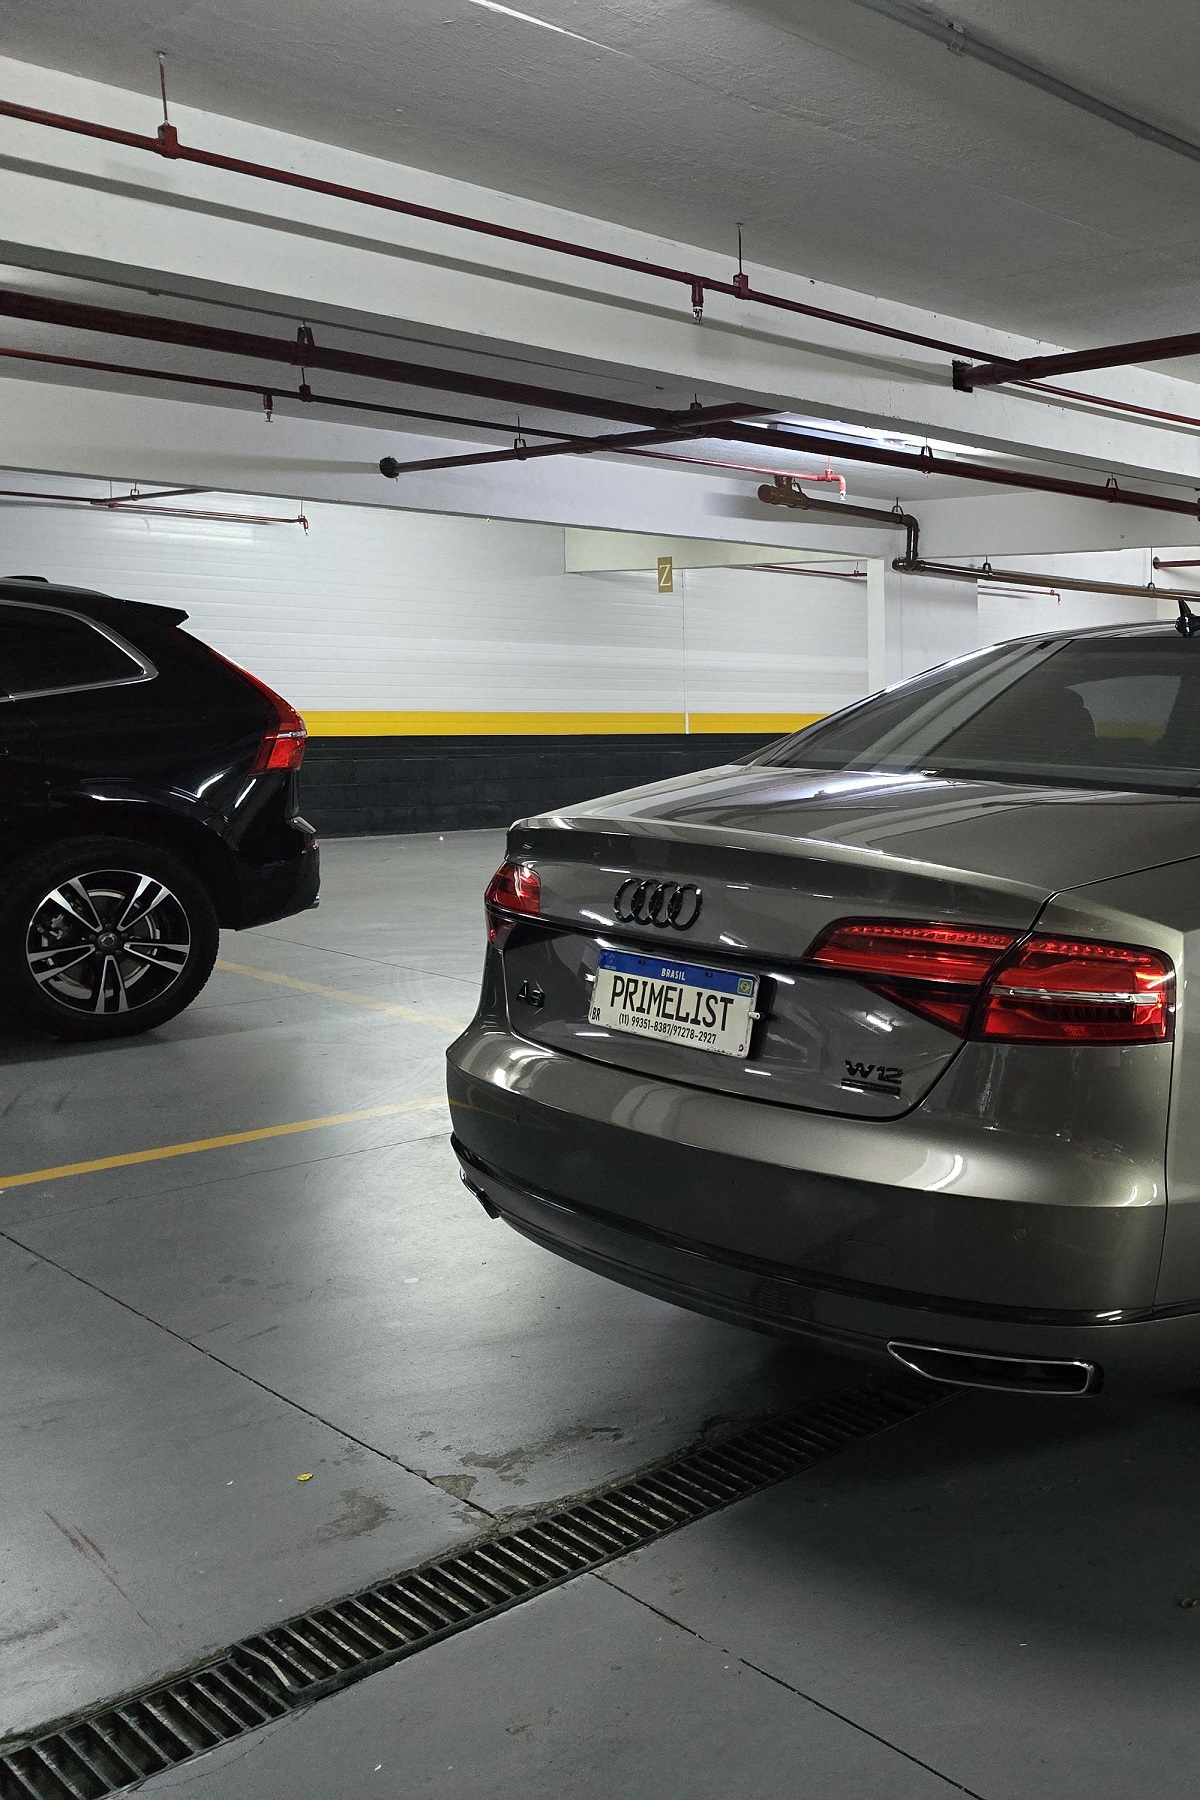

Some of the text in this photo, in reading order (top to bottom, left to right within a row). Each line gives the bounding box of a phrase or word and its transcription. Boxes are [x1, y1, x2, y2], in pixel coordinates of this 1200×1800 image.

[660, 564, 671, 586] Z
[661, 968, 686, 981] BRASIL
[591, 1007, 601, 1021] BR
[610, 975, 735, 1032] PRIMELIST
[618, 1013, 717, 1045] (11) 99351-8387/97278-2927
[845, 1060, 904, 1085] W12
